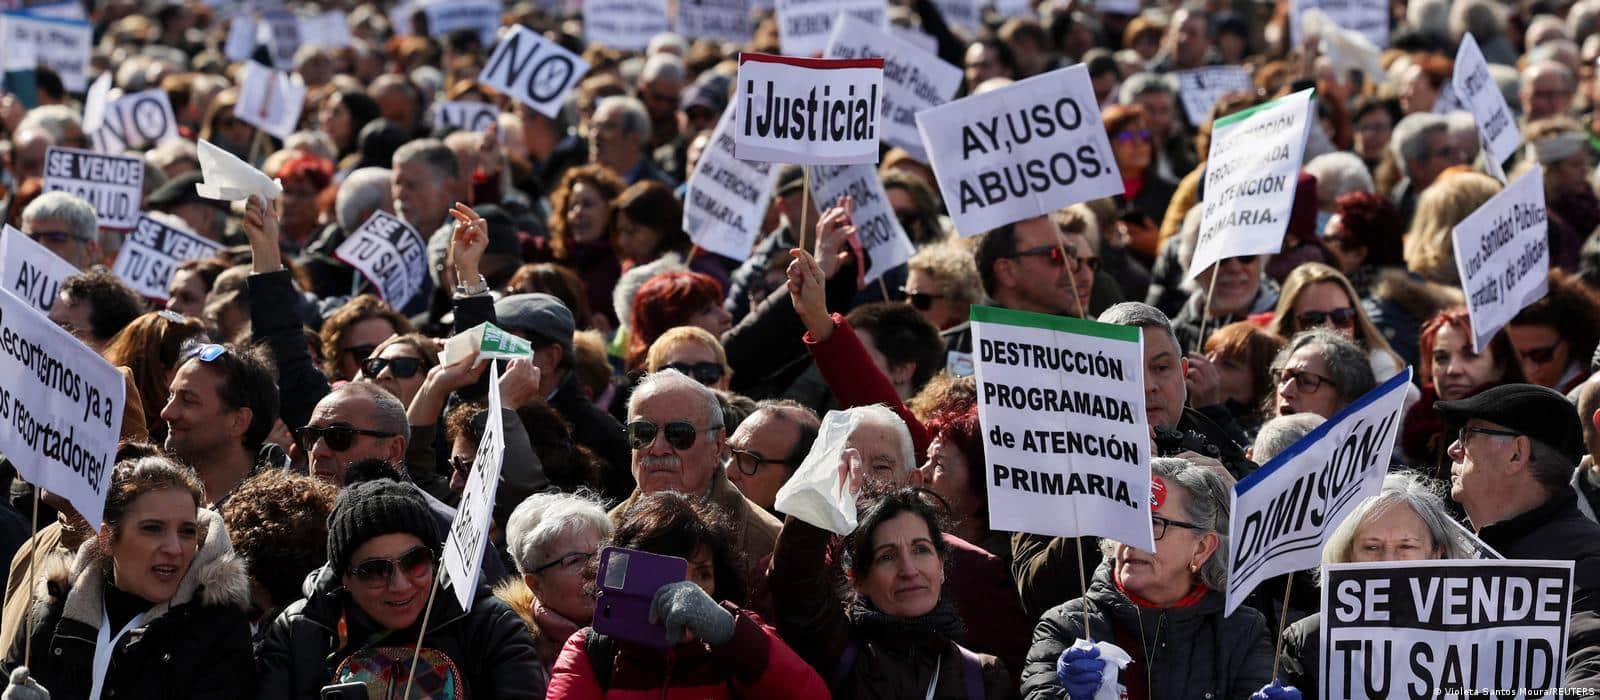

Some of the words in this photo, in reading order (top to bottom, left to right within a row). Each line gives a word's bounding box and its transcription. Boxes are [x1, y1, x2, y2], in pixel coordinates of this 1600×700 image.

[487, 32, 575, 104] NO
[962, 97, 1082, 161] AY,USO
[49, 152, 73, 178] SE
[78, 155, 140, 186] VENDE
[959, 145, 1112, 214] ABUSOS.
[133, 219, 163, 248] SE
[349, 236, 382, 261] TU
[367, 215, 400, 239] SE
[14, 260, 58, 311] AY,U
[122, 249, 148, 281] TU
[0, 306, 81, 403] ecortemos
[84, 380, 101, 422] ya
[104, 396, 113, 428] a
[979, 337, 1124, 382] DESTRUCCIÓN
[983, 381, 1135, 425] PROGRAMADA
[12, 397, 107, 496] recortadores!
[989, 425, 1016, 449] de
[1022, 429, 1139, 466] ATENCIÓN
[993, 463, 1139, 510] PRIMARIA.
[1232, 409, 1398, 574] DIMISIÓN!
[1335, 578, 1391, 623] SE
[1409, 576, 1563, 625] VENDE
[1335, 639, 1392, 700] TU
[1407, 638, 1554, 700] SALUD
